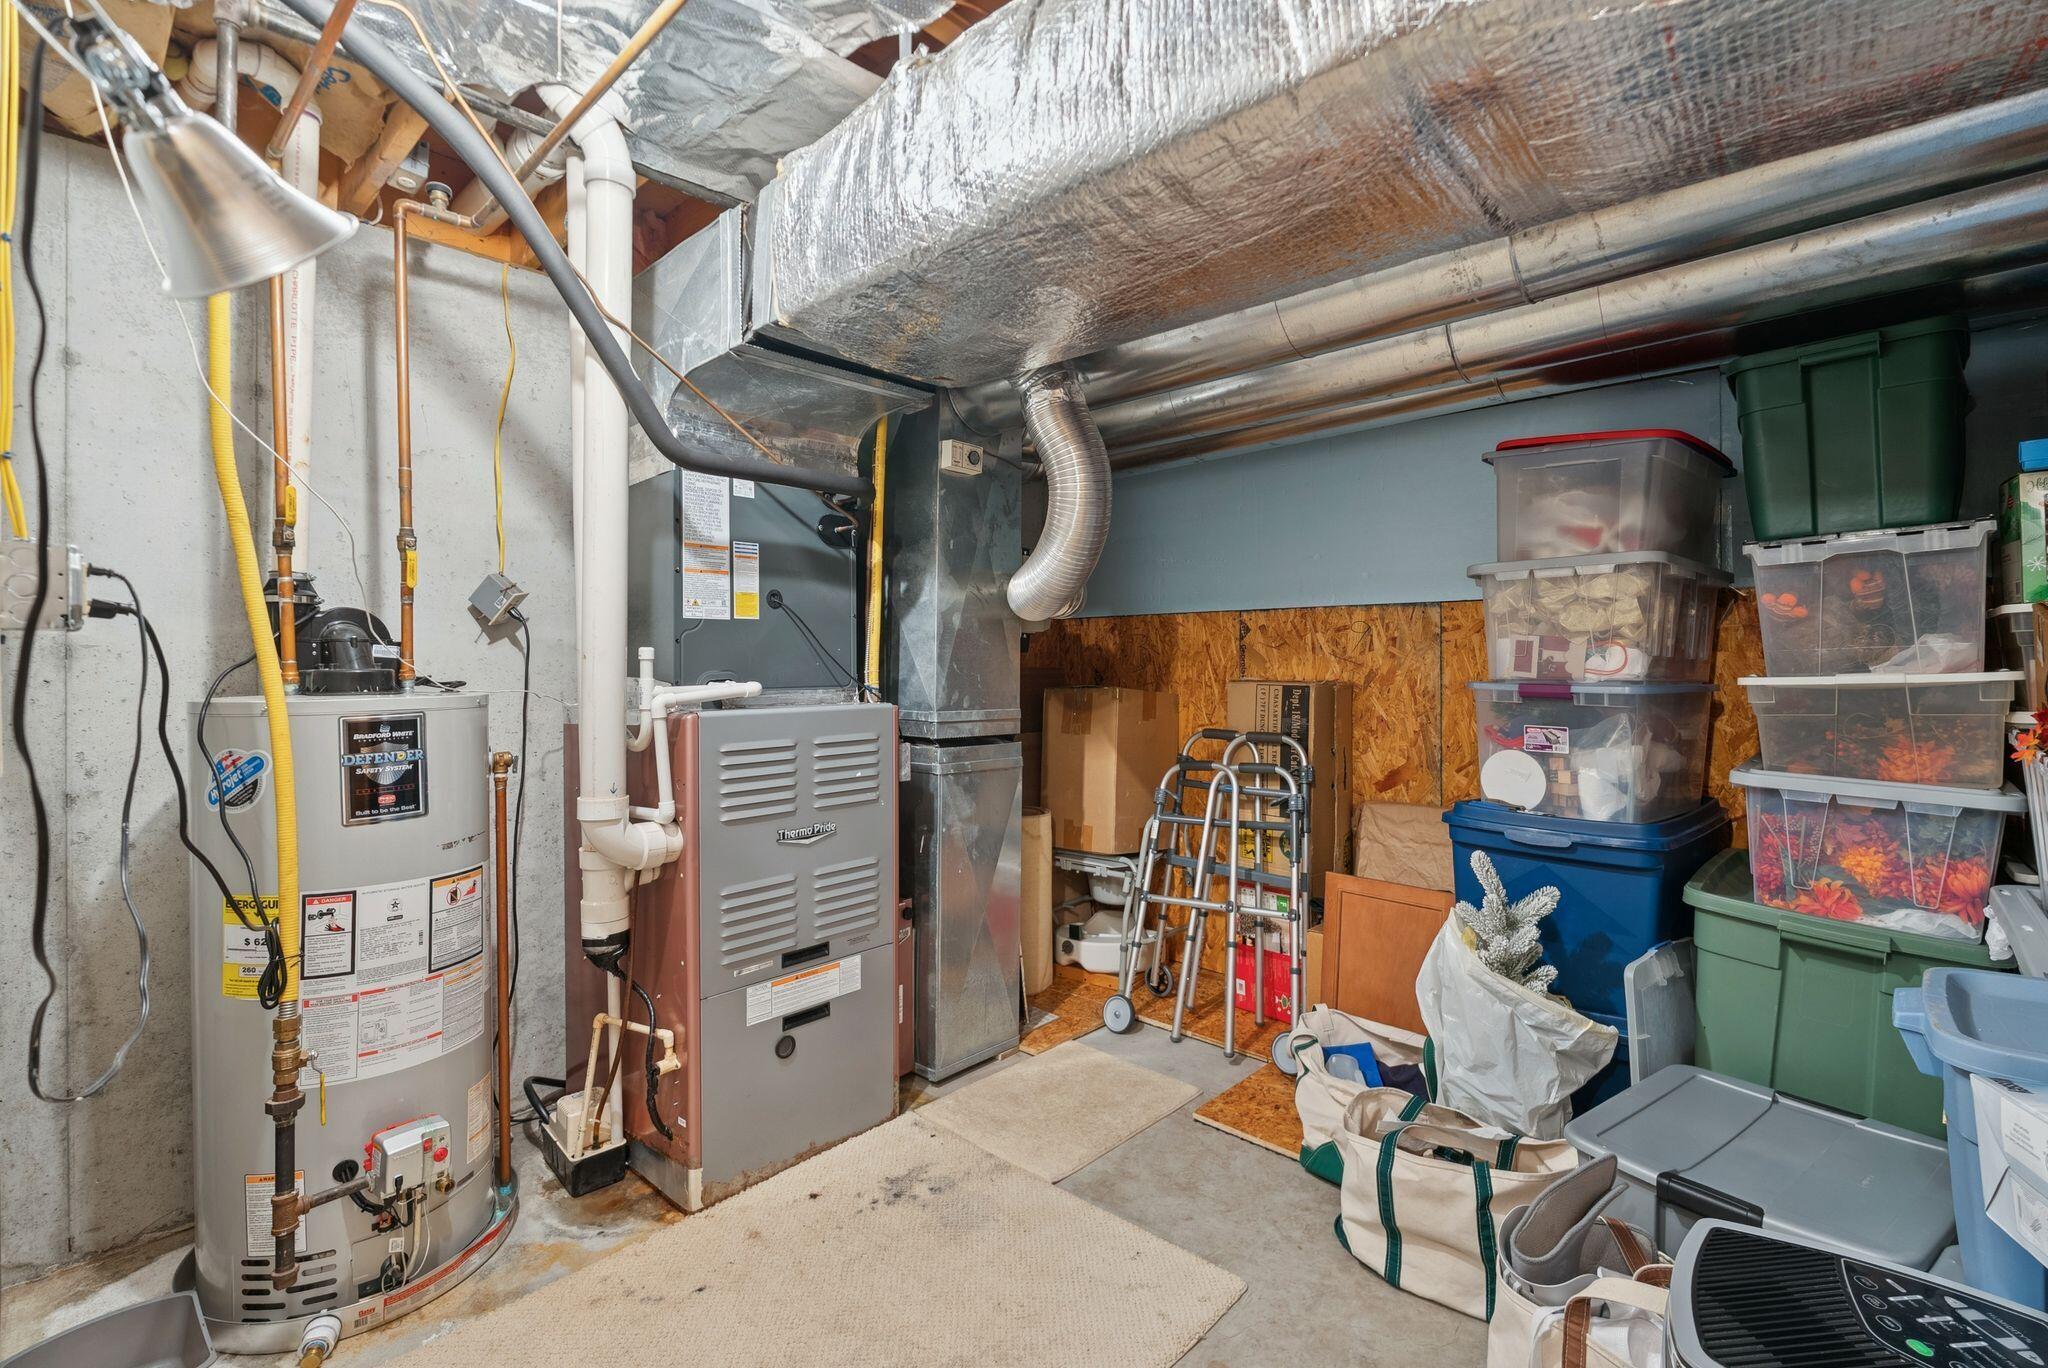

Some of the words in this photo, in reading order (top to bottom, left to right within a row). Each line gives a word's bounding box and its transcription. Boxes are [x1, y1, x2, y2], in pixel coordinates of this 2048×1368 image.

[290, 270, 299, 329] CHARLOTTE
[1290, 688, 1302, 709] Dept.
[353, 732, 391, 740] BRADFORD
[342, 749, 424, 767] DEFENDER
[355, 767, 383, 775] SAFETY
[384, 764, 413, 772] SYSTEM
[209, 768, 243, 802] Hyrojet
[778, 827, 812, 840] Thermo
[813, 822, 836, 834] Pride
[321, 896, 347, 904] DANGER
[244, 937, 251, 946] $
[254, 938, 268, 946] 62
